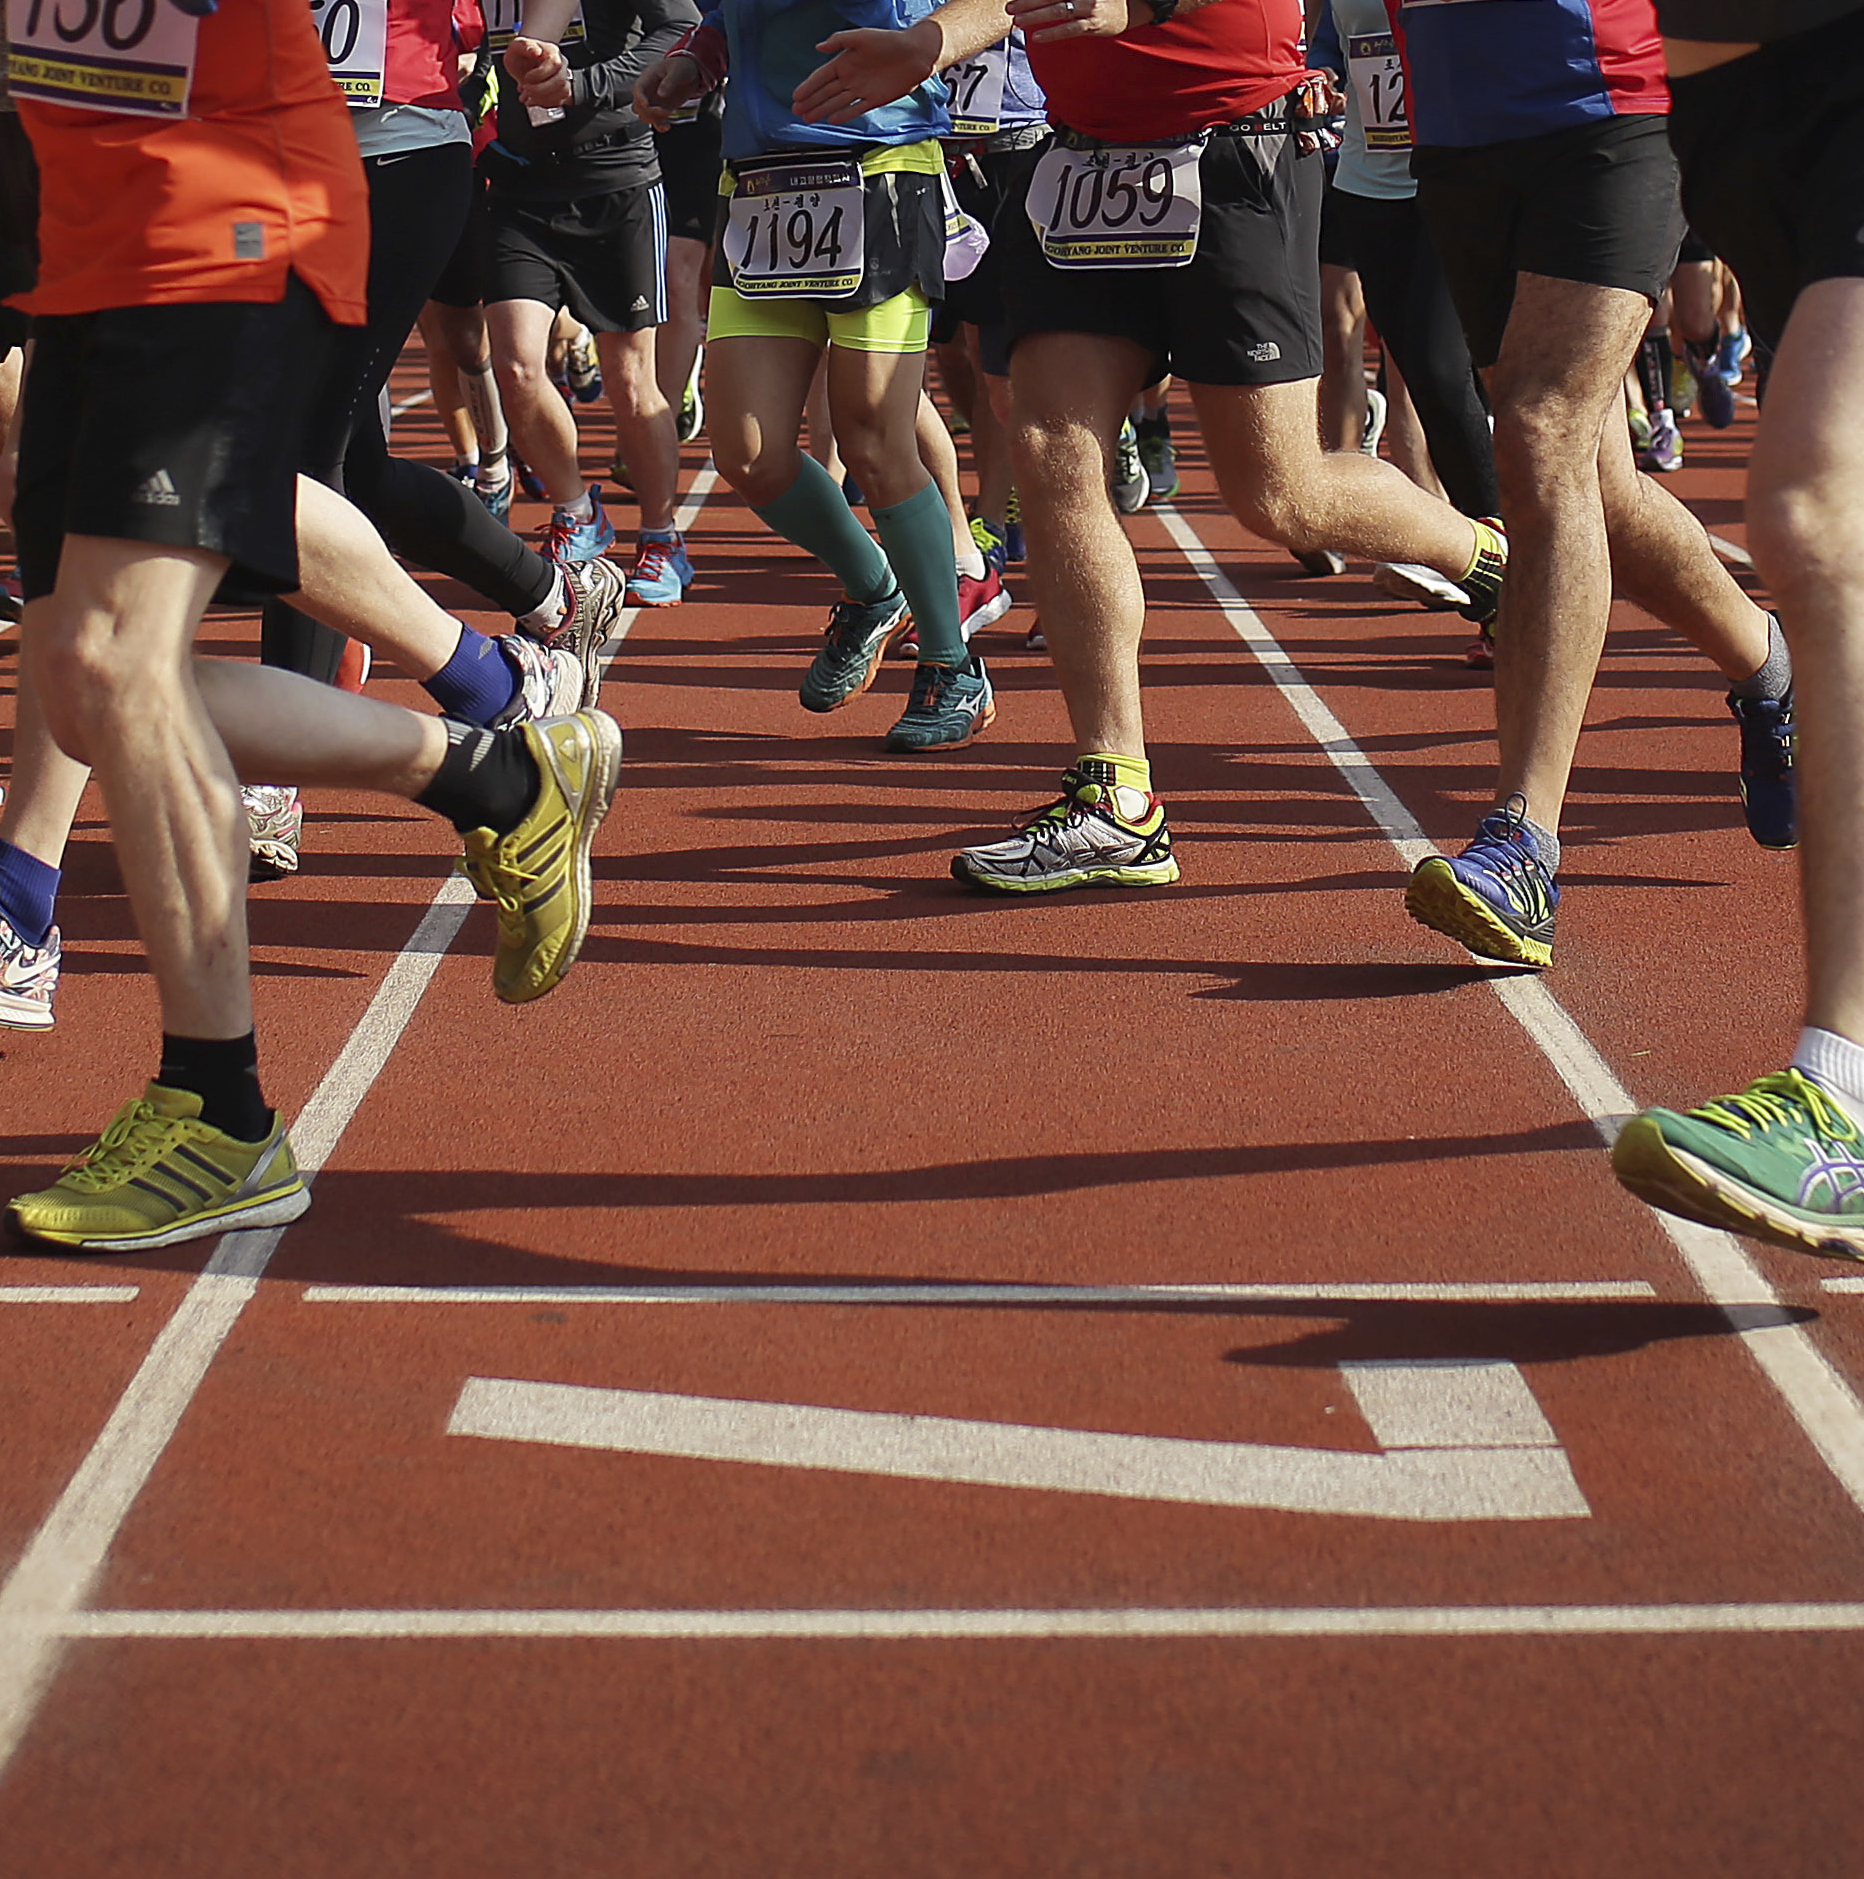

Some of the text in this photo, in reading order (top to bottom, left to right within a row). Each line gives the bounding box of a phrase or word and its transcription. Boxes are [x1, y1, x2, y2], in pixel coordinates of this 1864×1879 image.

[1229, 122, 1287, 132] GO BELT
[1050, 157, 1174, 232] 1059
[740, 205, 844, 271] 1194
[1094, 244, 1121, 255] JOINT
[1123, 243, 1168, 254] VENTURE
[779, 280, 802, 289] JOINT
[804, 278, 840, 288] VENTURE
[445, 1360, 1592, 1522] 7
